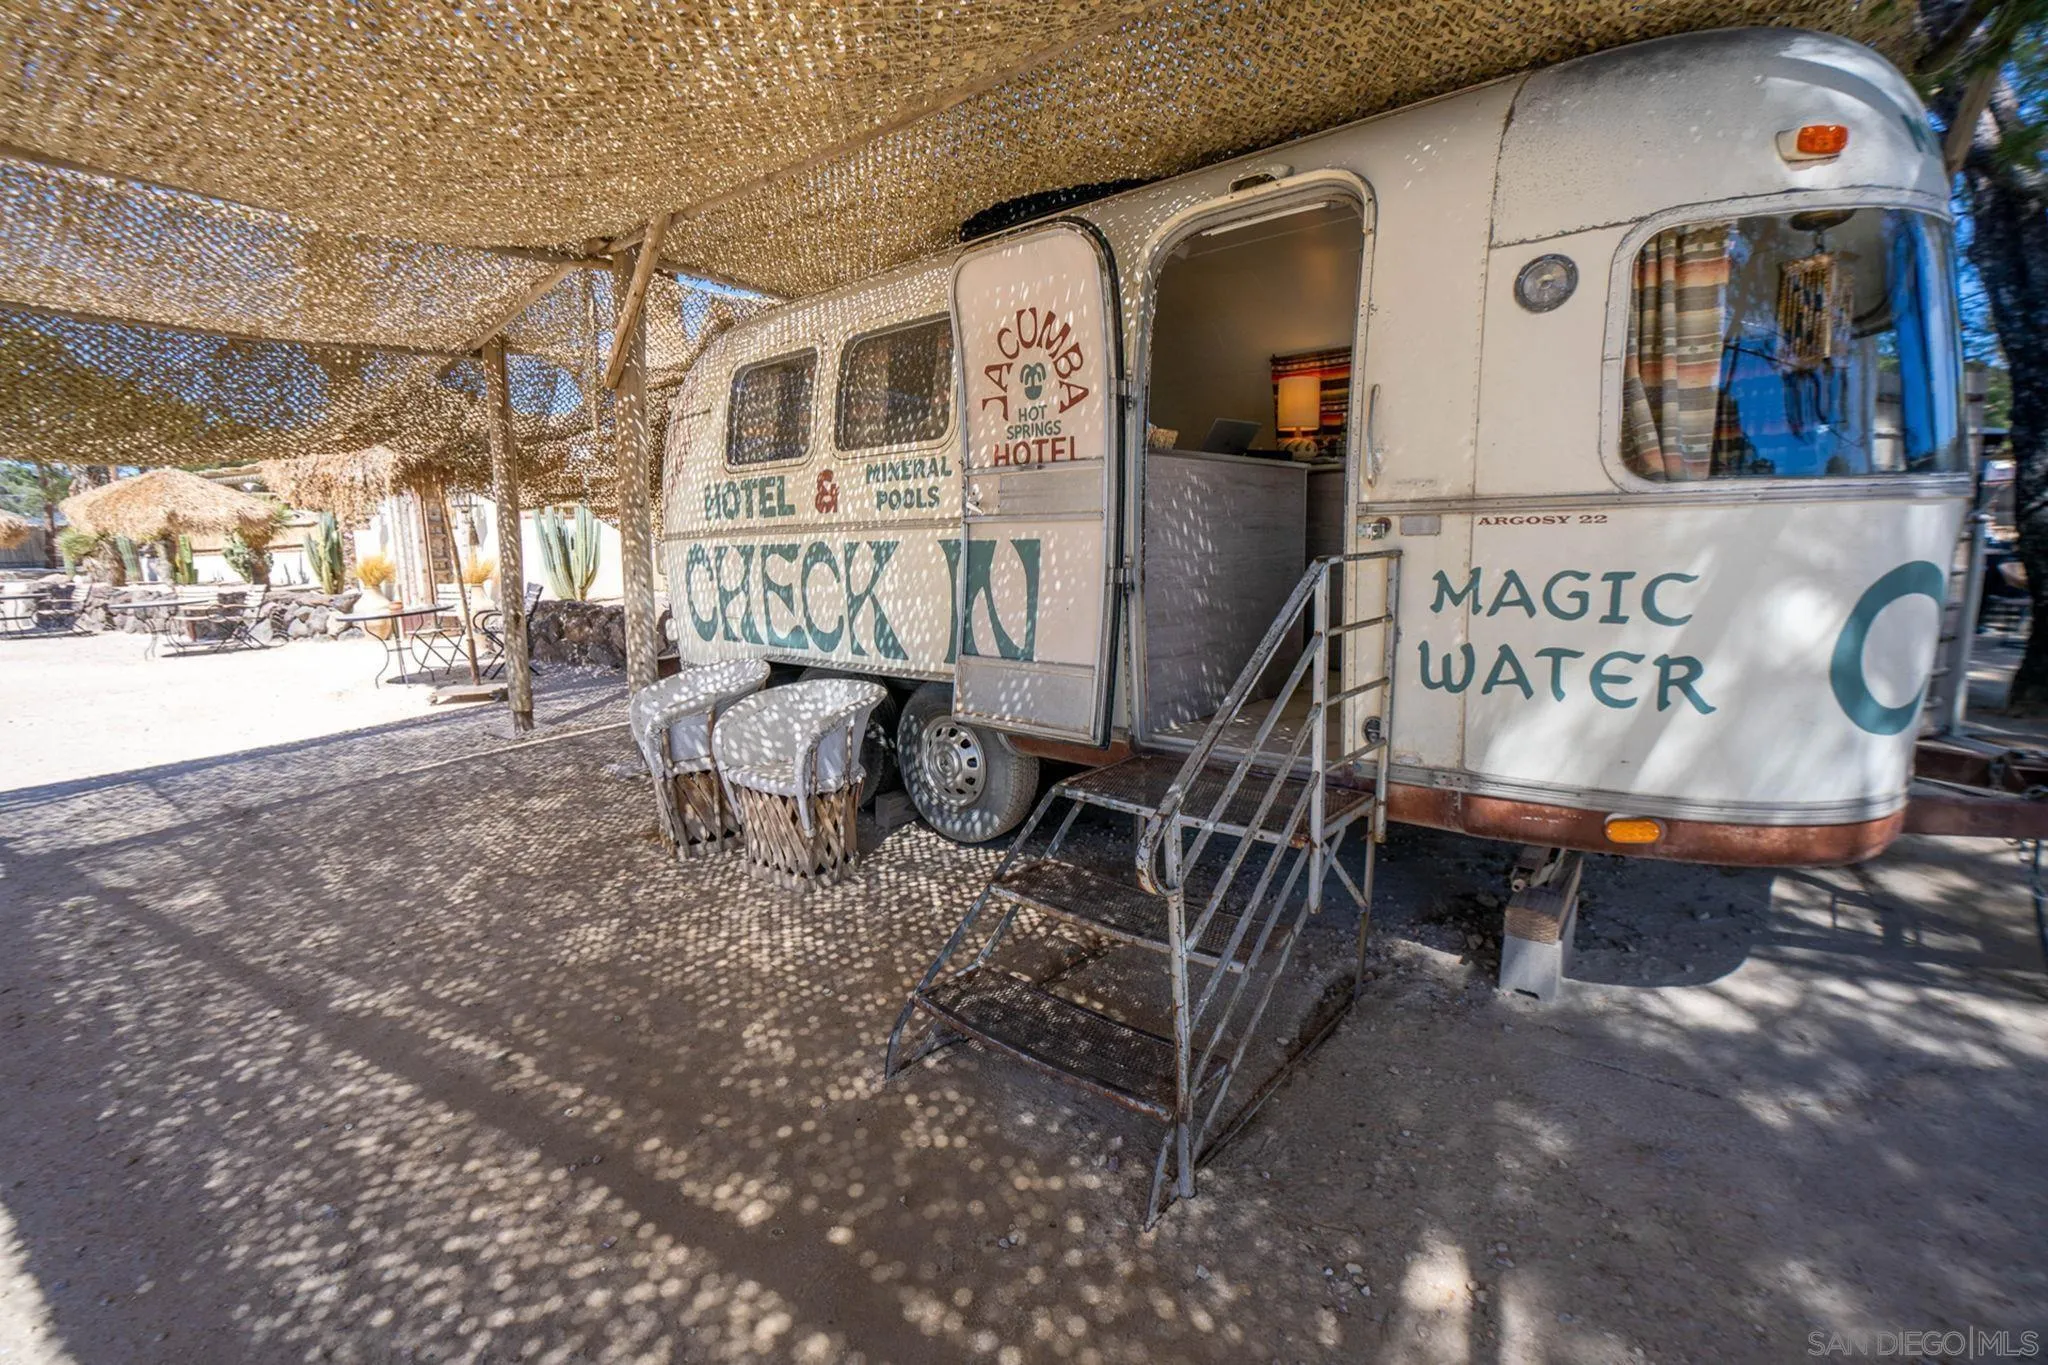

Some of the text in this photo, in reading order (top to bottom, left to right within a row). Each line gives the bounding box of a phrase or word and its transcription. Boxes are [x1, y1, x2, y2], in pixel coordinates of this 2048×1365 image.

[982, 307, 1089, 421] JACUMBA
[1018, 404, 1048, 422] HOT
[1006, 420, 1062, 440] SPRINGS
[994, 436, 1077, 467] HOTEL
[866, 456, 953, 485] MINERAL
[704, 469, 839, 520] HOTEL &
[876, 485, 941, 512] POOLS
[1478, 514, 1608, 526] ARGOSY 22
[686, 539, 1041, 664] CHECK IN
[1430, 567, 1699, 627] MAGIC
[1417, 640, 1717, 715] WATER
